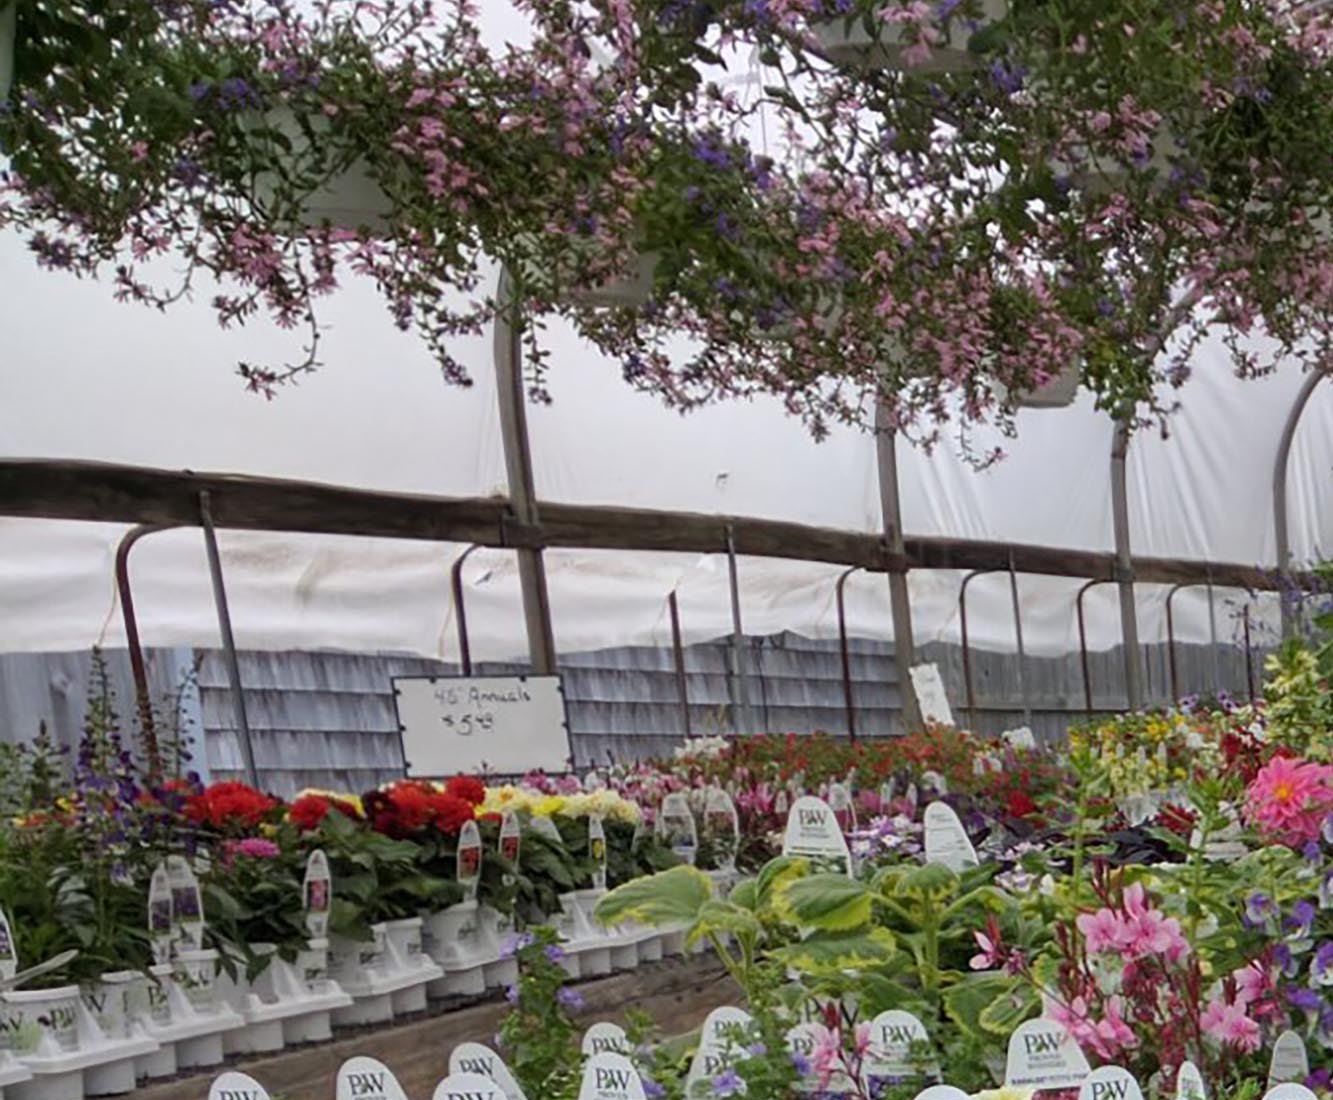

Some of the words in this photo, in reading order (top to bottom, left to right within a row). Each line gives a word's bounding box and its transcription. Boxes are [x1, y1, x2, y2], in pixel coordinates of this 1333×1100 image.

[1024, 1031, 1063, 1054] PW
[345, 1071, 385, 1096] PW
[595, 1067, 632, 1090] PW
